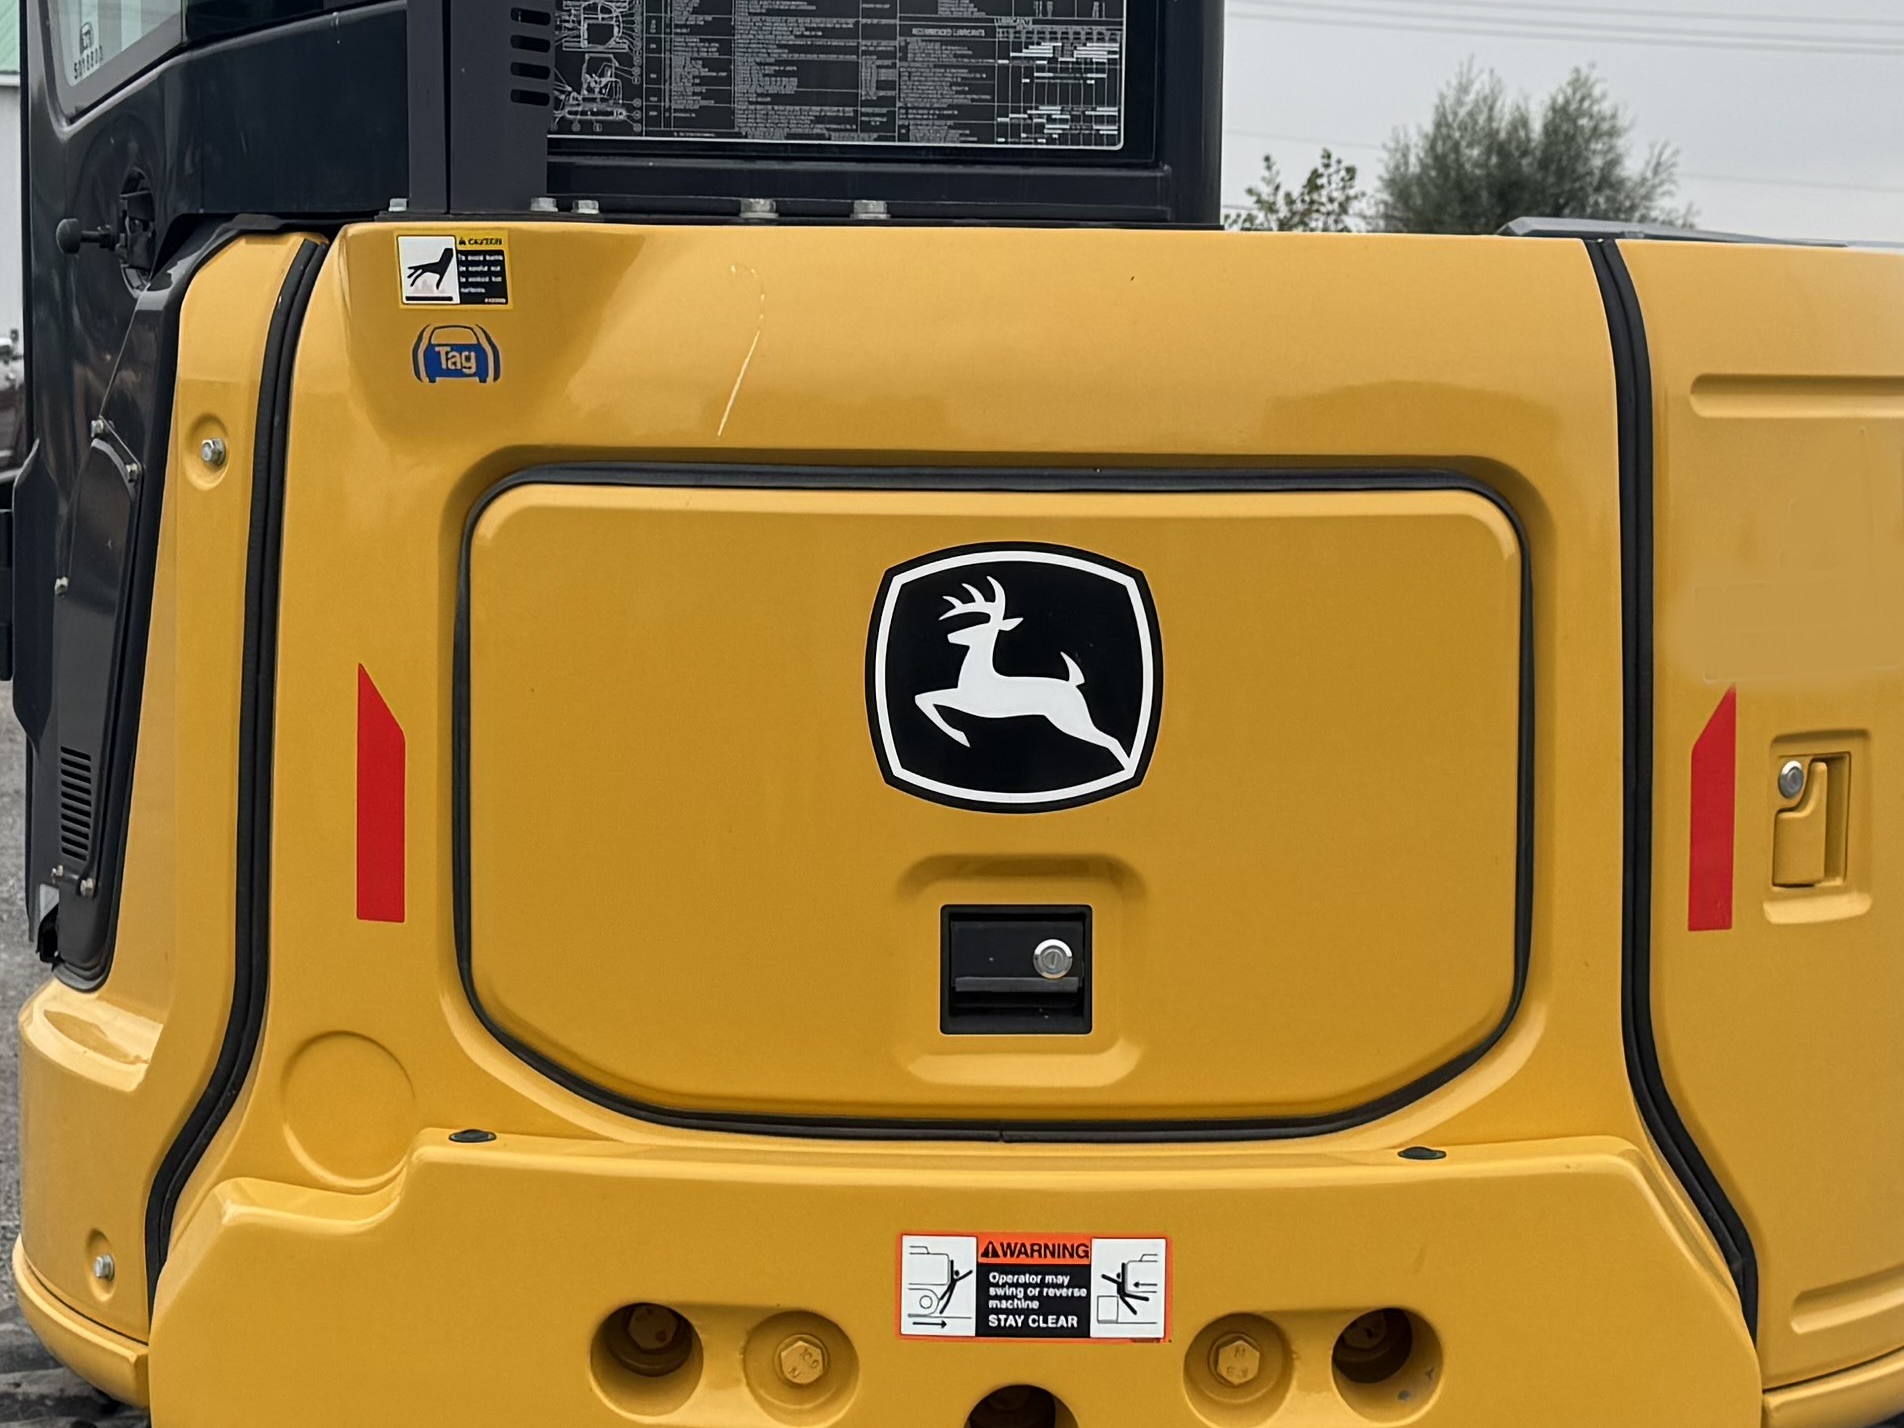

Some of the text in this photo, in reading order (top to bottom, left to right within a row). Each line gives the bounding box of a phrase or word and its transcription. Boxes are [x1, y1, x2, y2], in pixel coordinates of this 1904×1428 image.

[435, 346, 477, 374] Tag
[1000, 1243, 1090, 1260] WARNING
[989, 1272, 1070, 1286] Operator may
[989, 1287, 1087, 1298] swing or reverse
[989, 1298, 1039, 1310] machine
[988, 1315, 1078, 1328] STAY CLEAR
